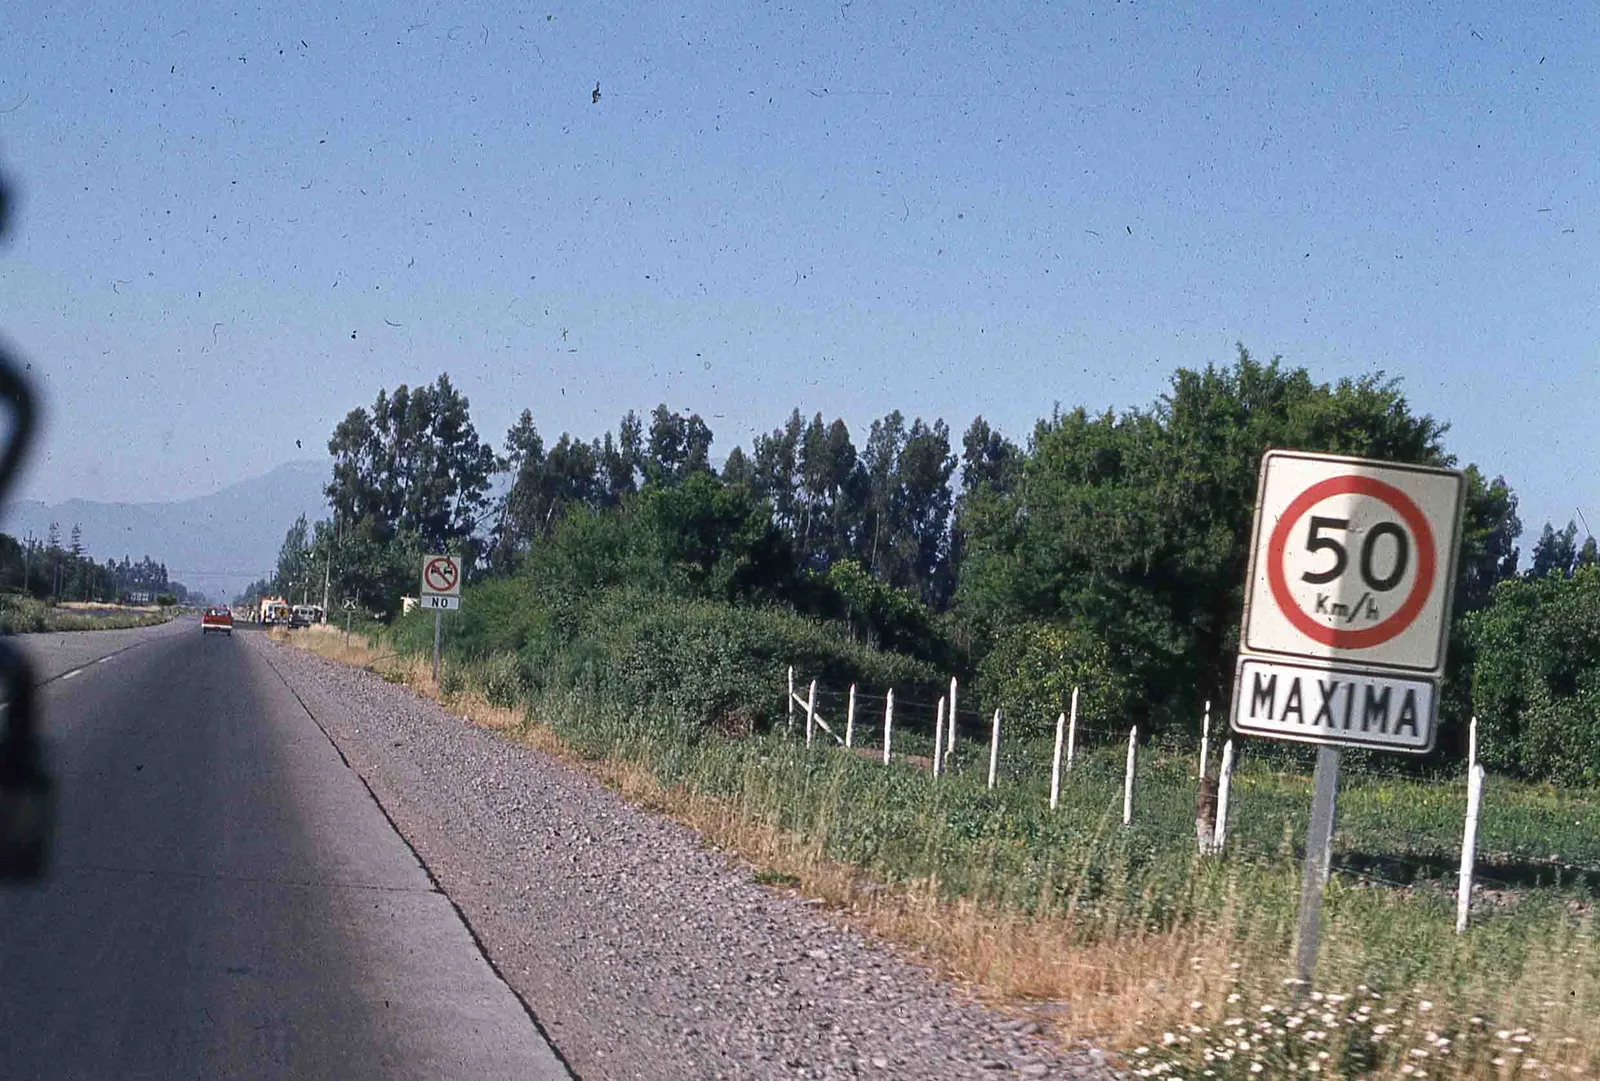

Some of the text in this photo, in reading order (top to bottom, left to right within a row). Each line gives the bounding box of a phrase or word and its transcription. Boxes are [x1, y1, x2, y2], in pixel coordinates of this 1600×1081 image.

[1301, 515, 1408, 592] 50
[431, 598, 448, 608] NO
[1314, 592, 1380, 623] Km/h
[1249, 671, 1419, 738] MAXIMA
